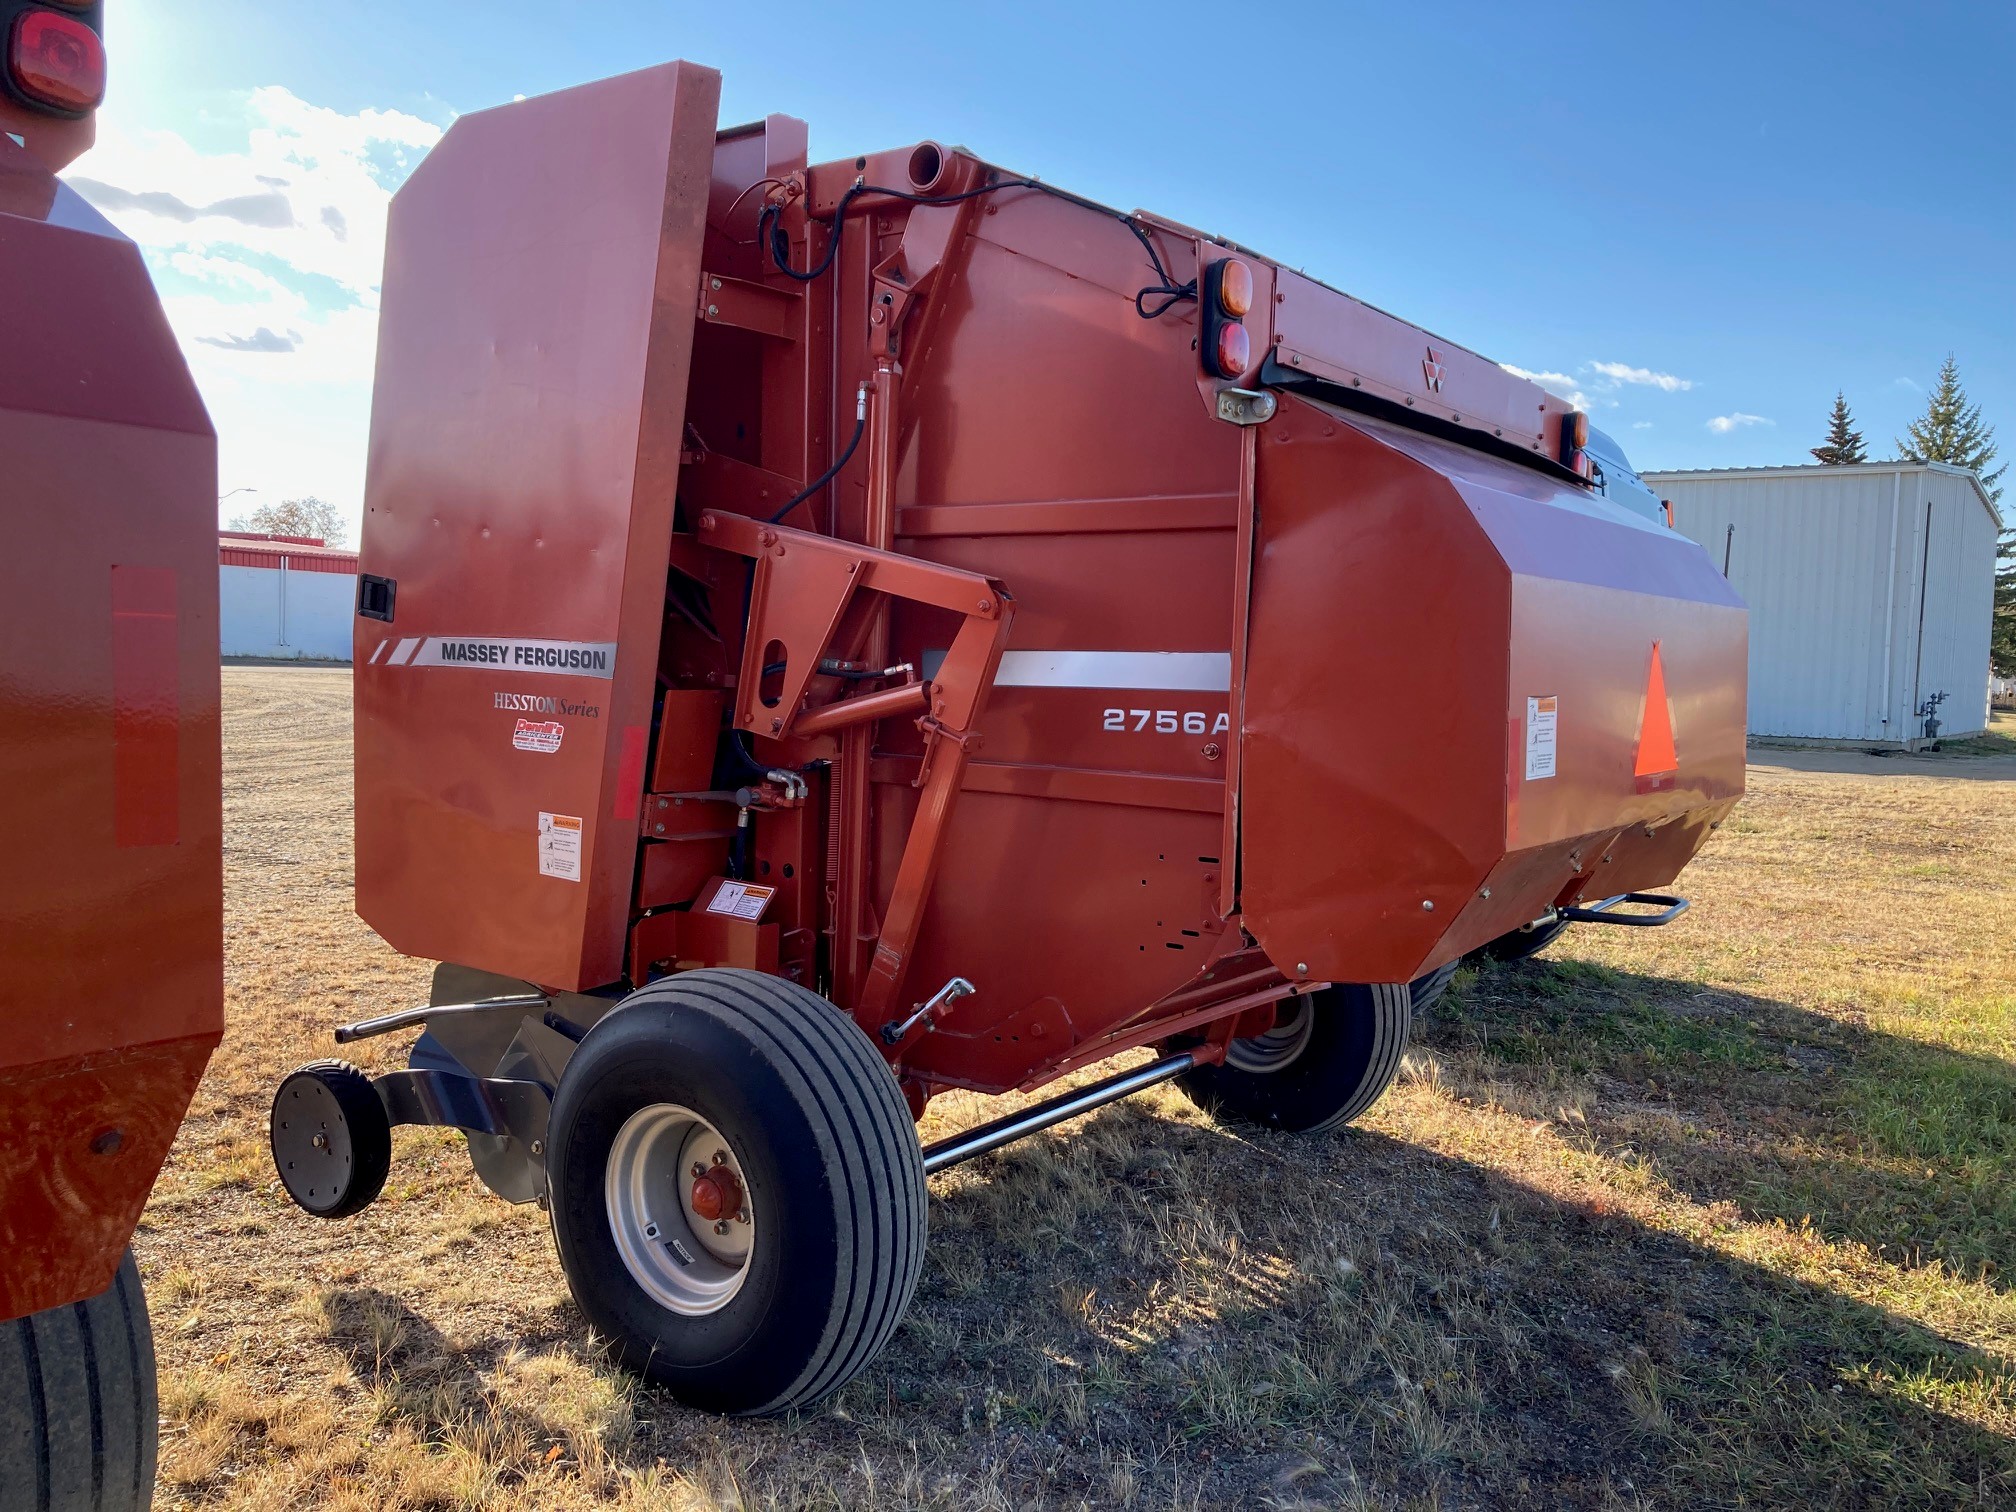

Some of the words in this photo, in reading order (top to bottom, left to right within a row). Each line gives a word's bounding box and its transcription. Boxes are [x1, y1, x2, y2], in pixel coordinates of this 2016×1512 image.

[442, 643, 509, 664] MASSEY
[514, 646, 606, 670] FERGUSON
[493, 692, 557, 714] HESSTON
[558, 698, 600, 718] Series
[1103, 708, 1229, 735] 2756A
[676, 1243, 691, 1260] NOTICE
